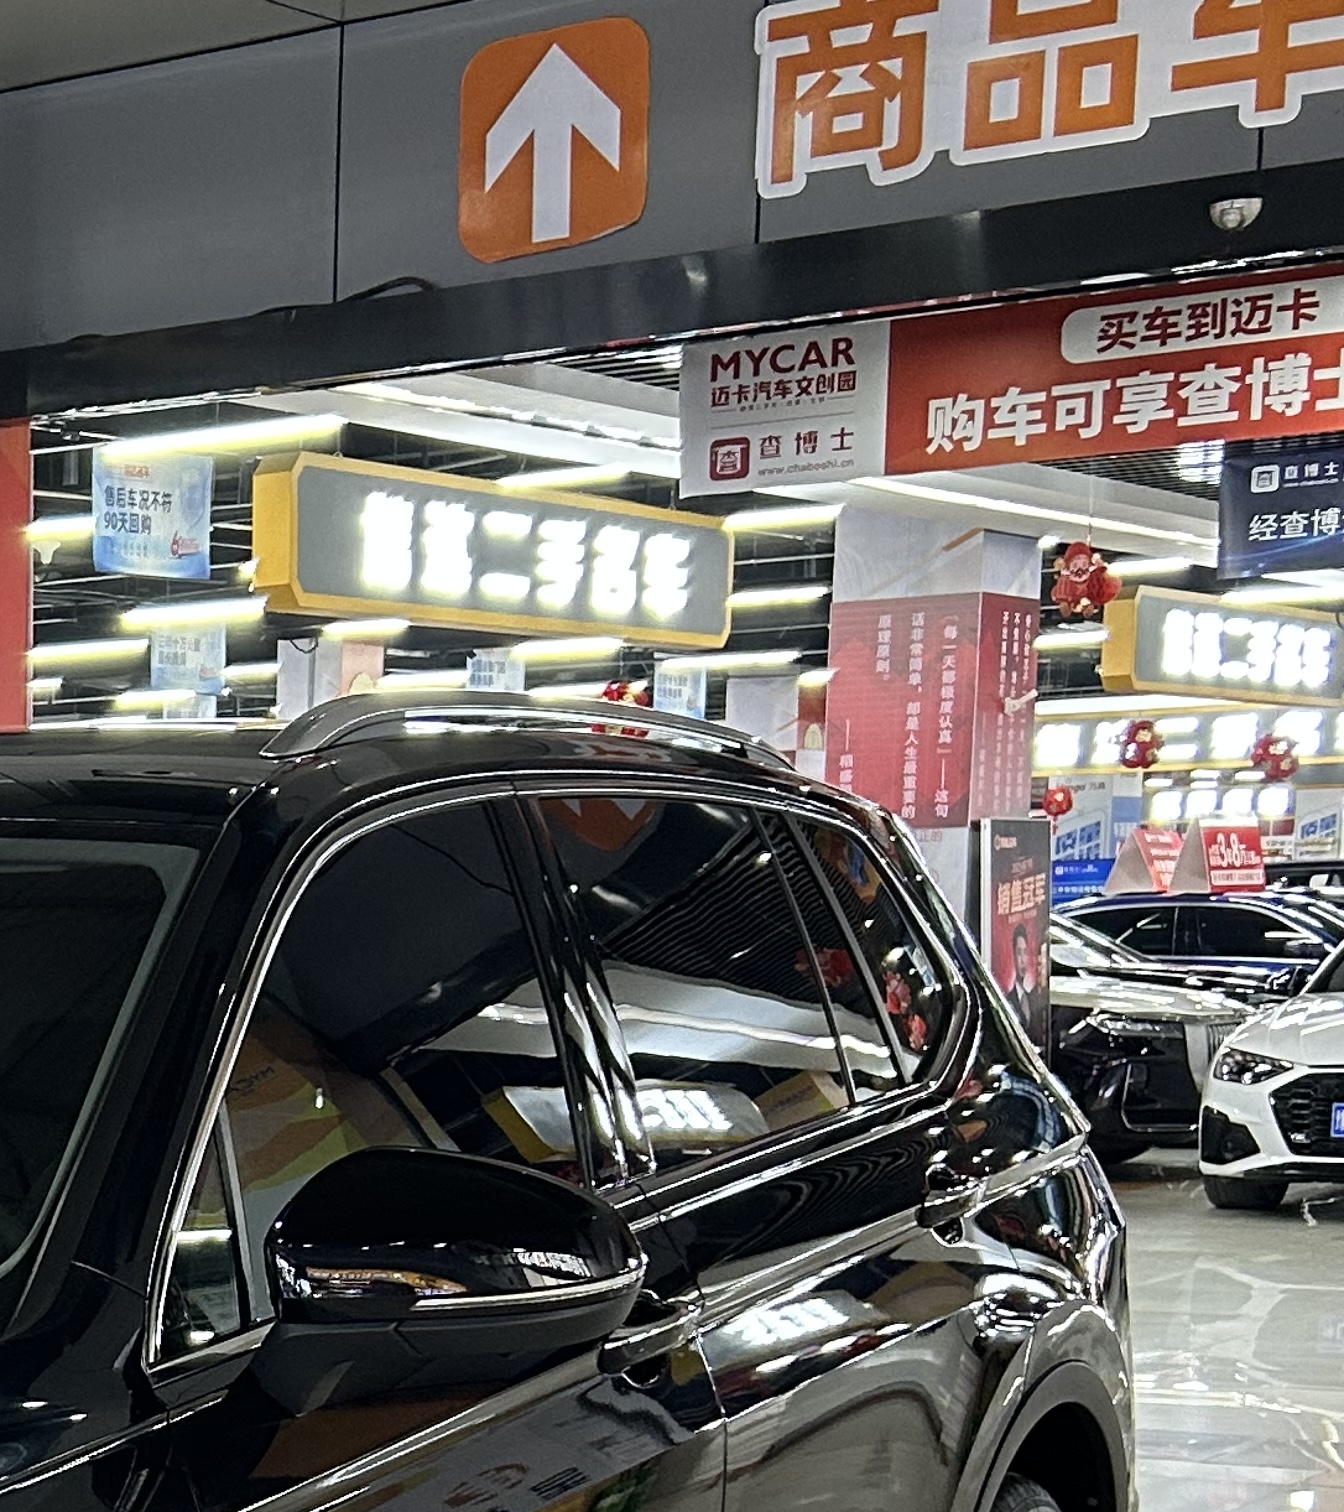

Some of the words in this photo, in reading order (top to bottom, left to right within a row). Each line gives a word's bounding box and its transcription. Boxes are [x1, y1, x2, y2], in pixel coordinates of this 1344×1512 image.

[1096, 288, 1321, 354] 买车到迈卡
[711, 337, 856, 382] MYCAR
[711, 370, 857, 408] 迈卡汽车文创园
[759, 427, 855, 460] 查博士
[1248, 507, 1344, 541] 经查博
